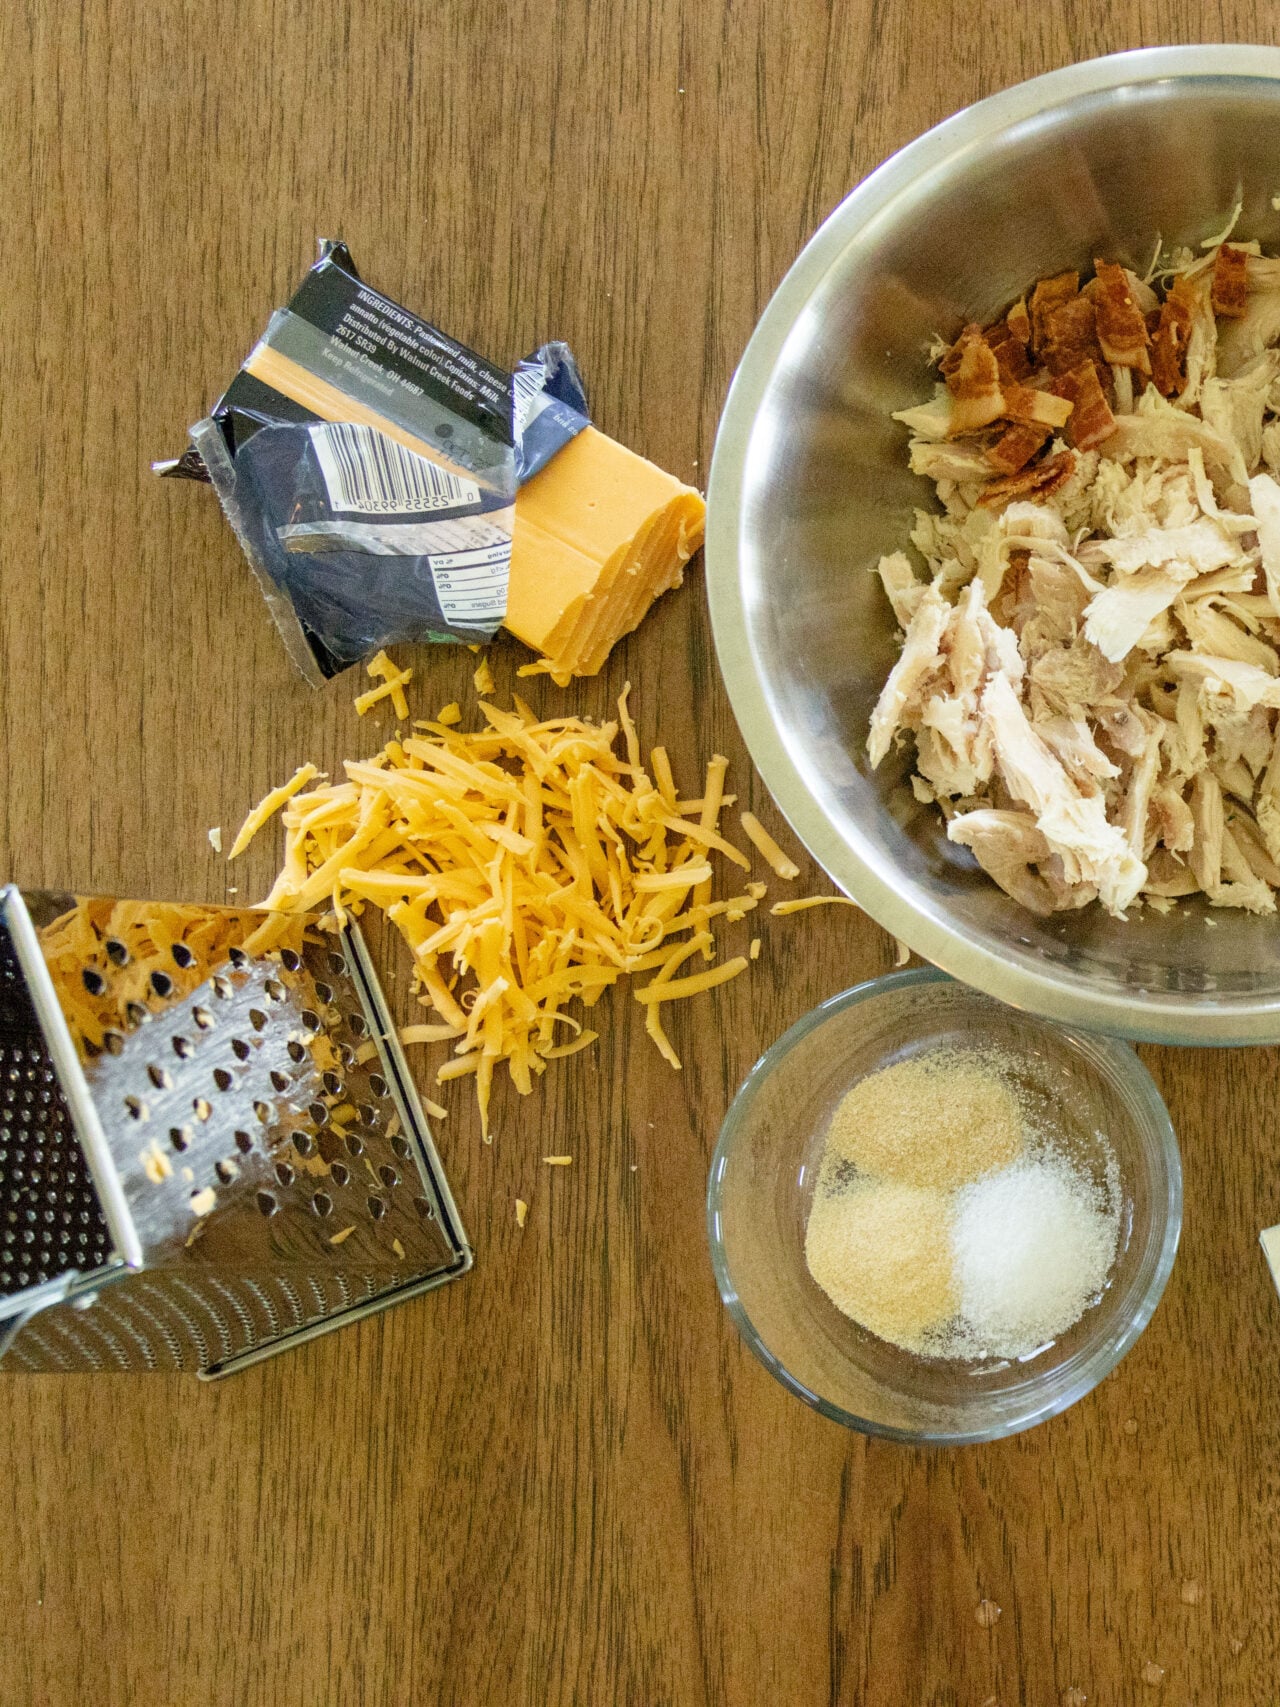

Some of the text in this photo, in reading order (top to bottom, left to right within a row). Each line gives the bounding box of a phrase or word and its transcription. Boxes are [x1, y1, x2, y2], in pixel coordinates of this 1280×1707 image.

[322, 347, 343, 367] Keep
[330, 335, 360, 359] Walnut
[386, 370, 401, 384] OH
[335, 324, 377, 354] 2617 SR39
[343, 313, 475, 400] Distributed By Walnut Creek Foods
[349, 303, 379, 324] annatto
[378, 320, 420, 350] (vegetable
[444, 360, 480, 390] Contains:
[479, 386, 500, 403] Milk
[357, 290, 415, 330] INGREDIENTS:
[478, 370, 507, 392] cheese
